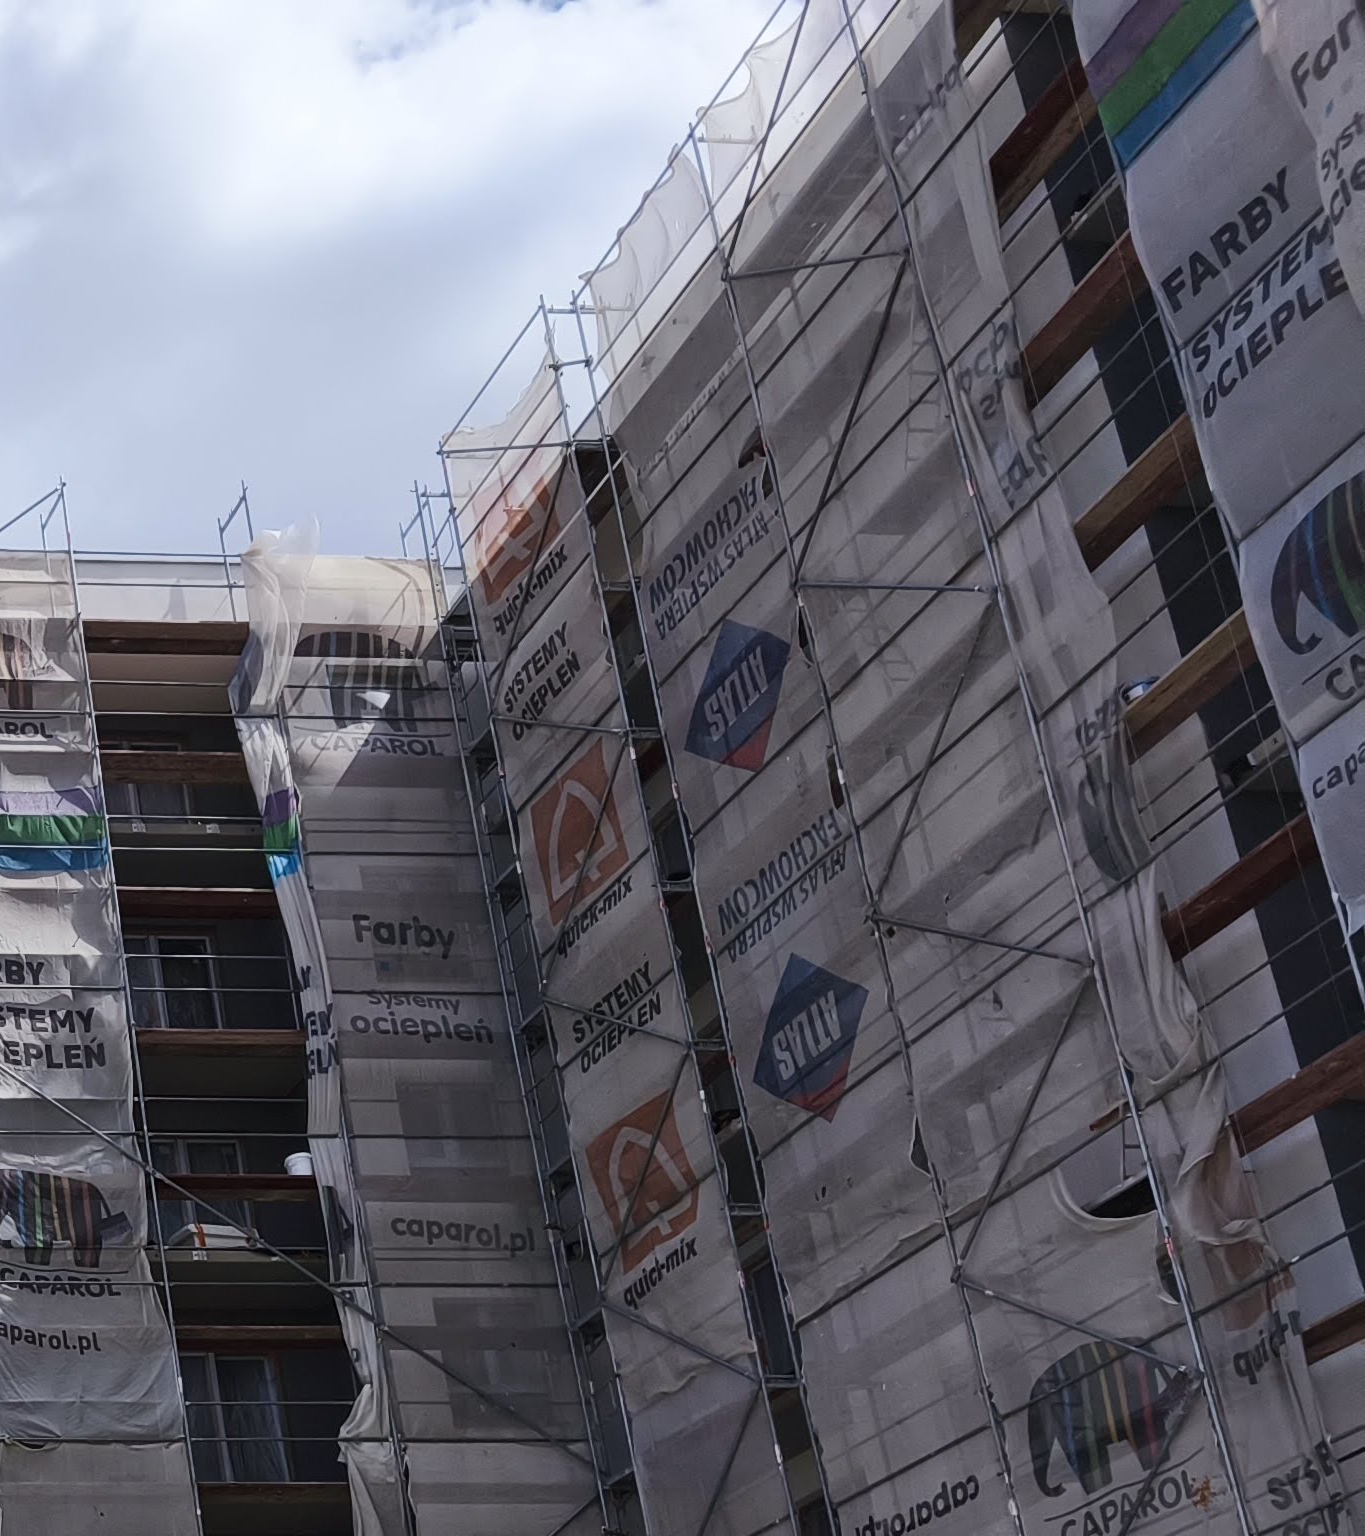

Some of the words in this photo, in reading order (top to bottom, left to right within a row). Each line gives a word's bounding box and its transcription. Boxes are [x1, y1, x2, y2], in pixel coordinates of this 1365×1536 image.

[1160, 165, 1292, 316] FARBY
[1191, 215, 1335, 373] SYSTEM
[1202, 257, 1350, 420] OCIEPLE
[723, 510, 770, 570] ATLAS
[654, 556, 725, 641] WSPIERA
[503, 620, 569, 714] SYSTEMY
[511, 647, 581, 742] OCIEPLEŃ
[704, 645, 769, 743] ATLAS
[311, 731, 445, 759] CAPAROL
[718, 807, 843, 937] FACHOWCÓW
[352, 913, 456, 960] Farby
[557, 875, 634, 959] quick-mix
[350, 1010, 495, 1046] ociepleń
[572, 960, 654, 1044] SYSTEMY
[580, 989, 662, 1075] OCIEPLEŃ
[772, 988, 843, 1083] ATLAS
[390, 1213, 536, 1257] caparol.pl
